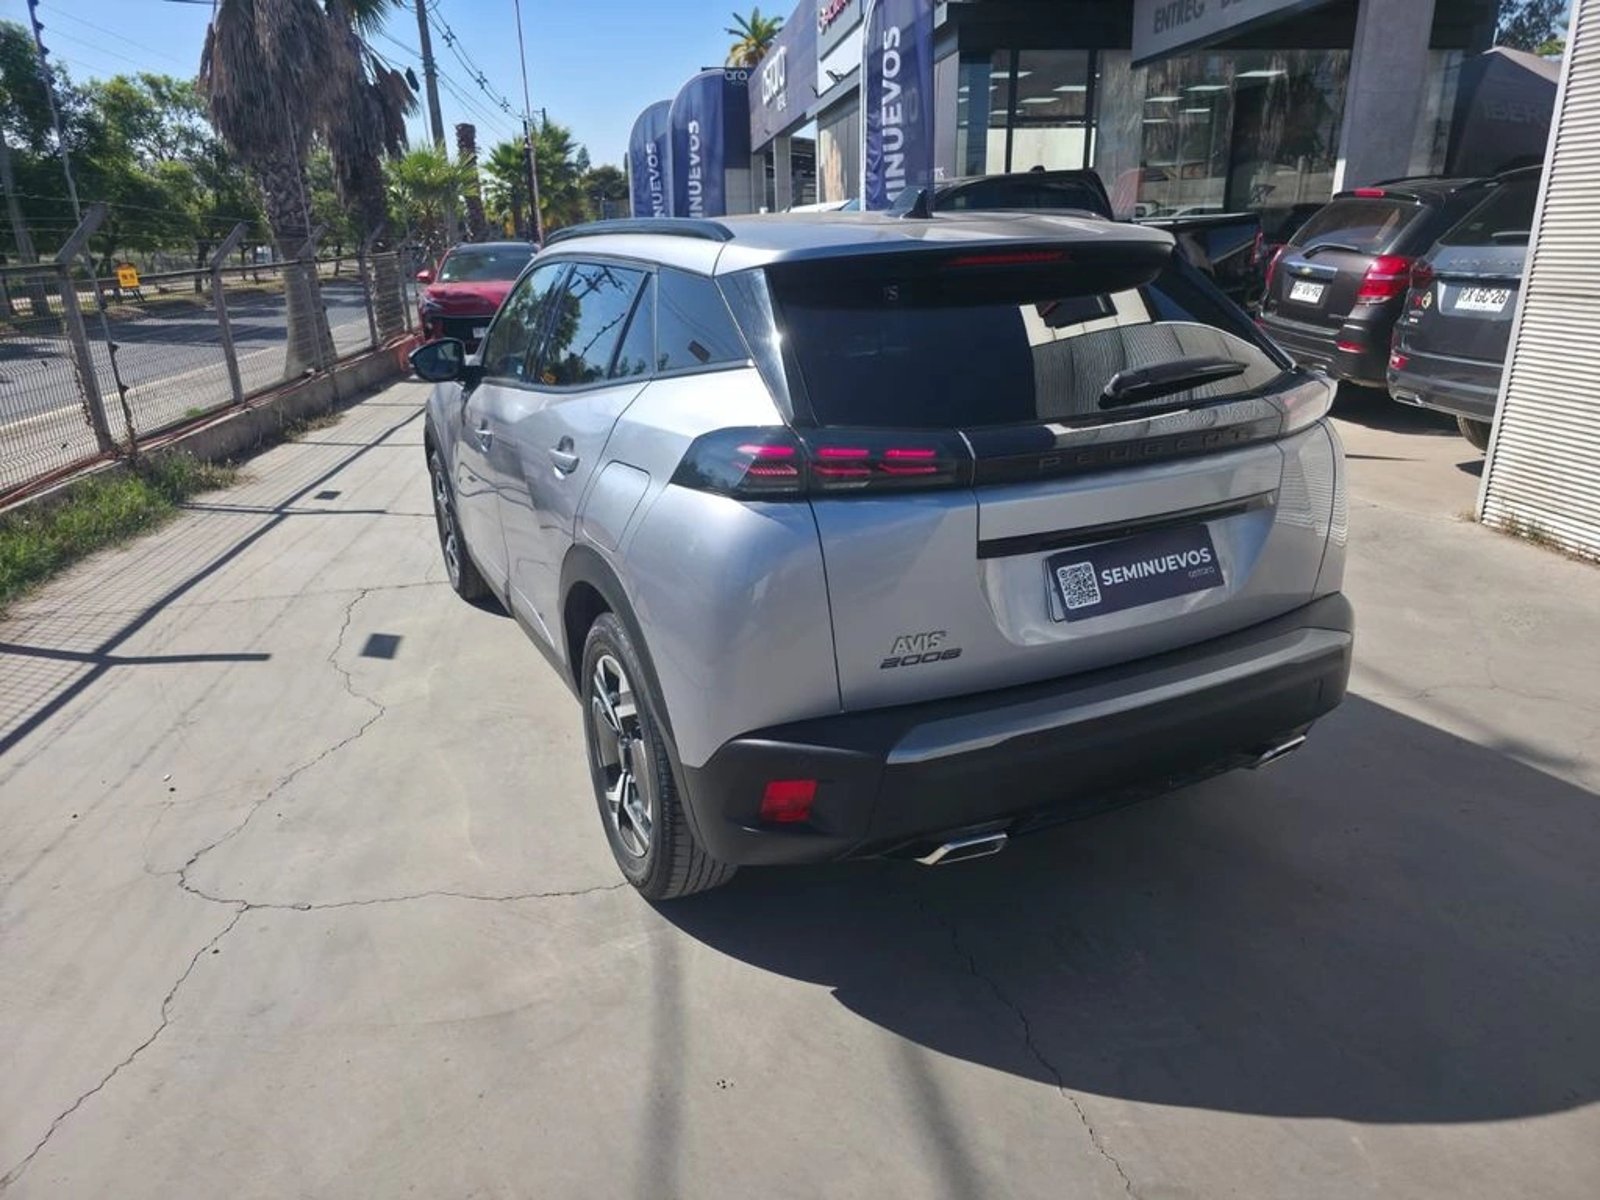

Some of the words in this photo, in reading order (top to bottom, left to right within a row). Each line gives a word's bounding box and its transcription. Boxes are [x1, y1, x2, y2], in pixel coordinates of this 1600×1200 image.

[1101, 548, 1211, 585] SEMINUEVOS
[891, 631, 946, 654] AVIS
[880, 648, 962, 669] 2008
